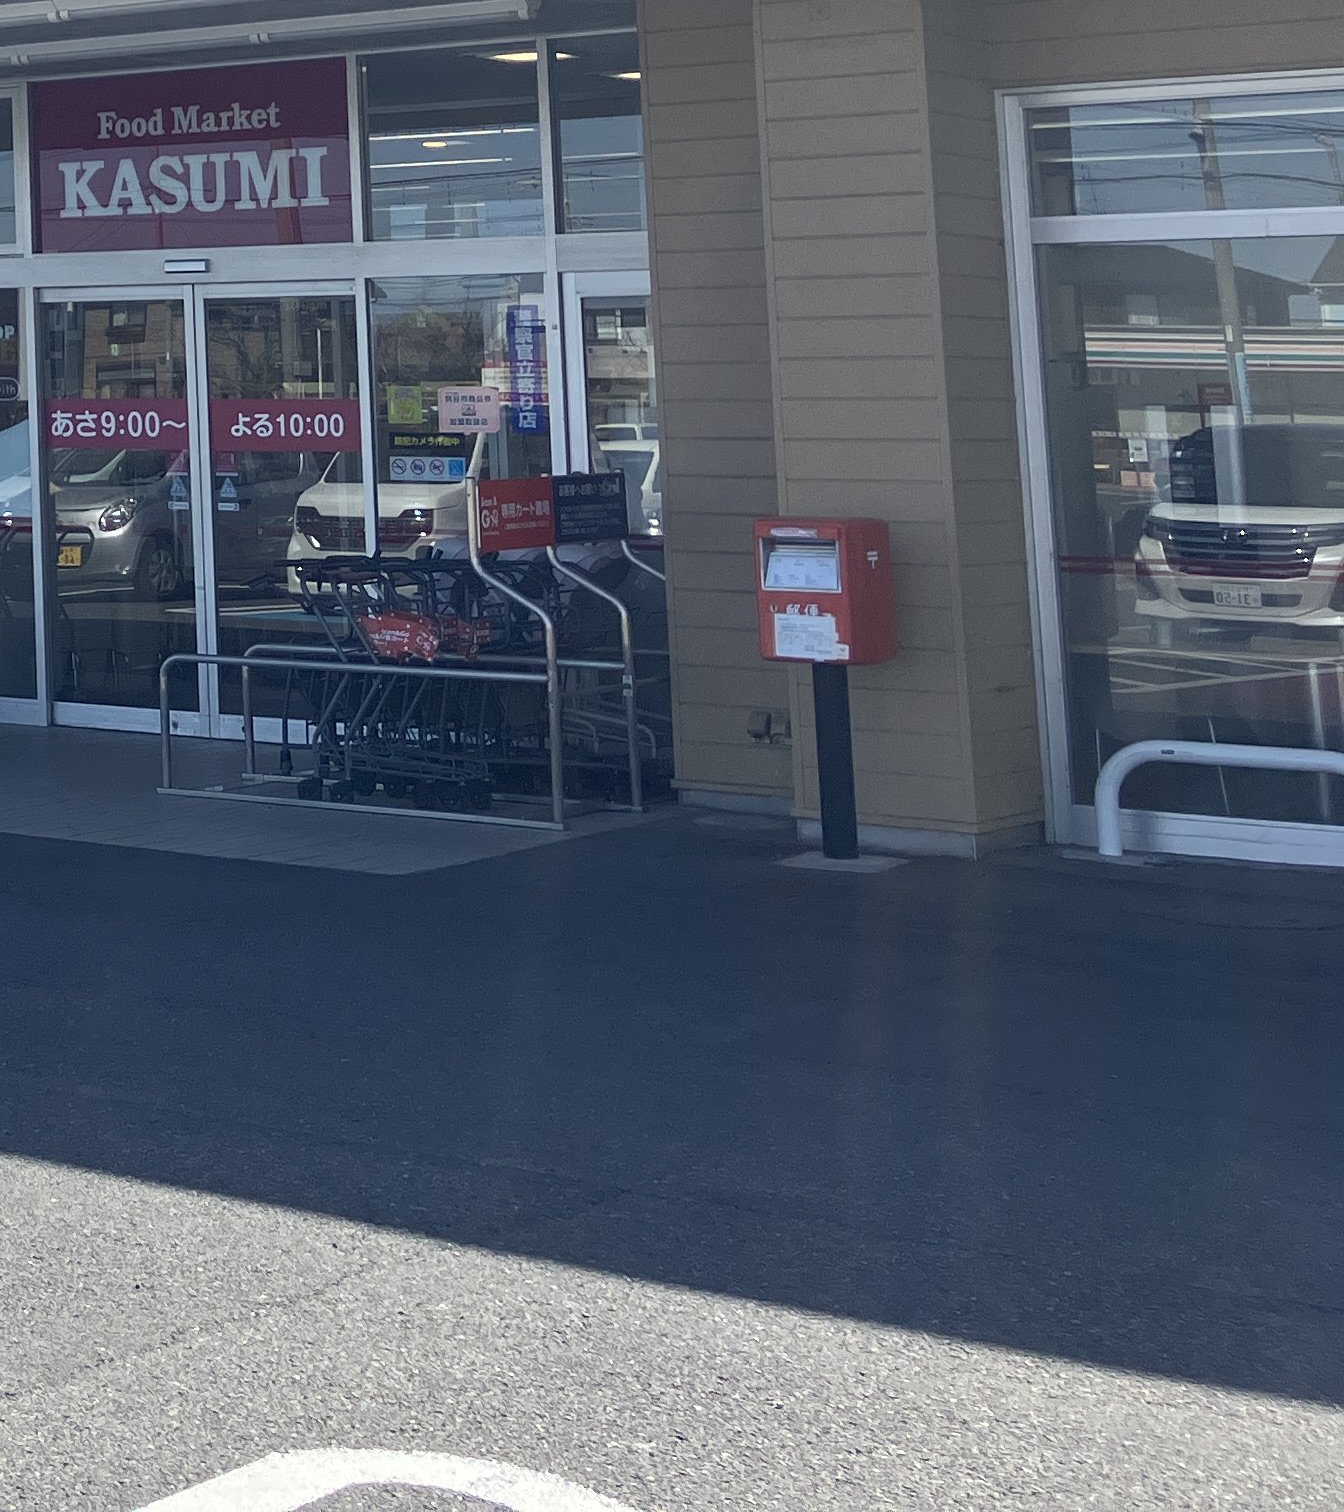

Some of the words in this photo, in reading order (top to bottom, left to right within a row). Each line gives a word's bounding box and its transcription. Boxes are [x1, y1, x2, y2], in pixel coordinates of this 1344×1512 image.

[97, 108, 164, 139] Food
[170, 102, 281, 134] Market
[58, 146, 330, 218] KASUMI
[230, 413, 345, 438] よる10:00
[786, 604, 818, 616] 郵便
